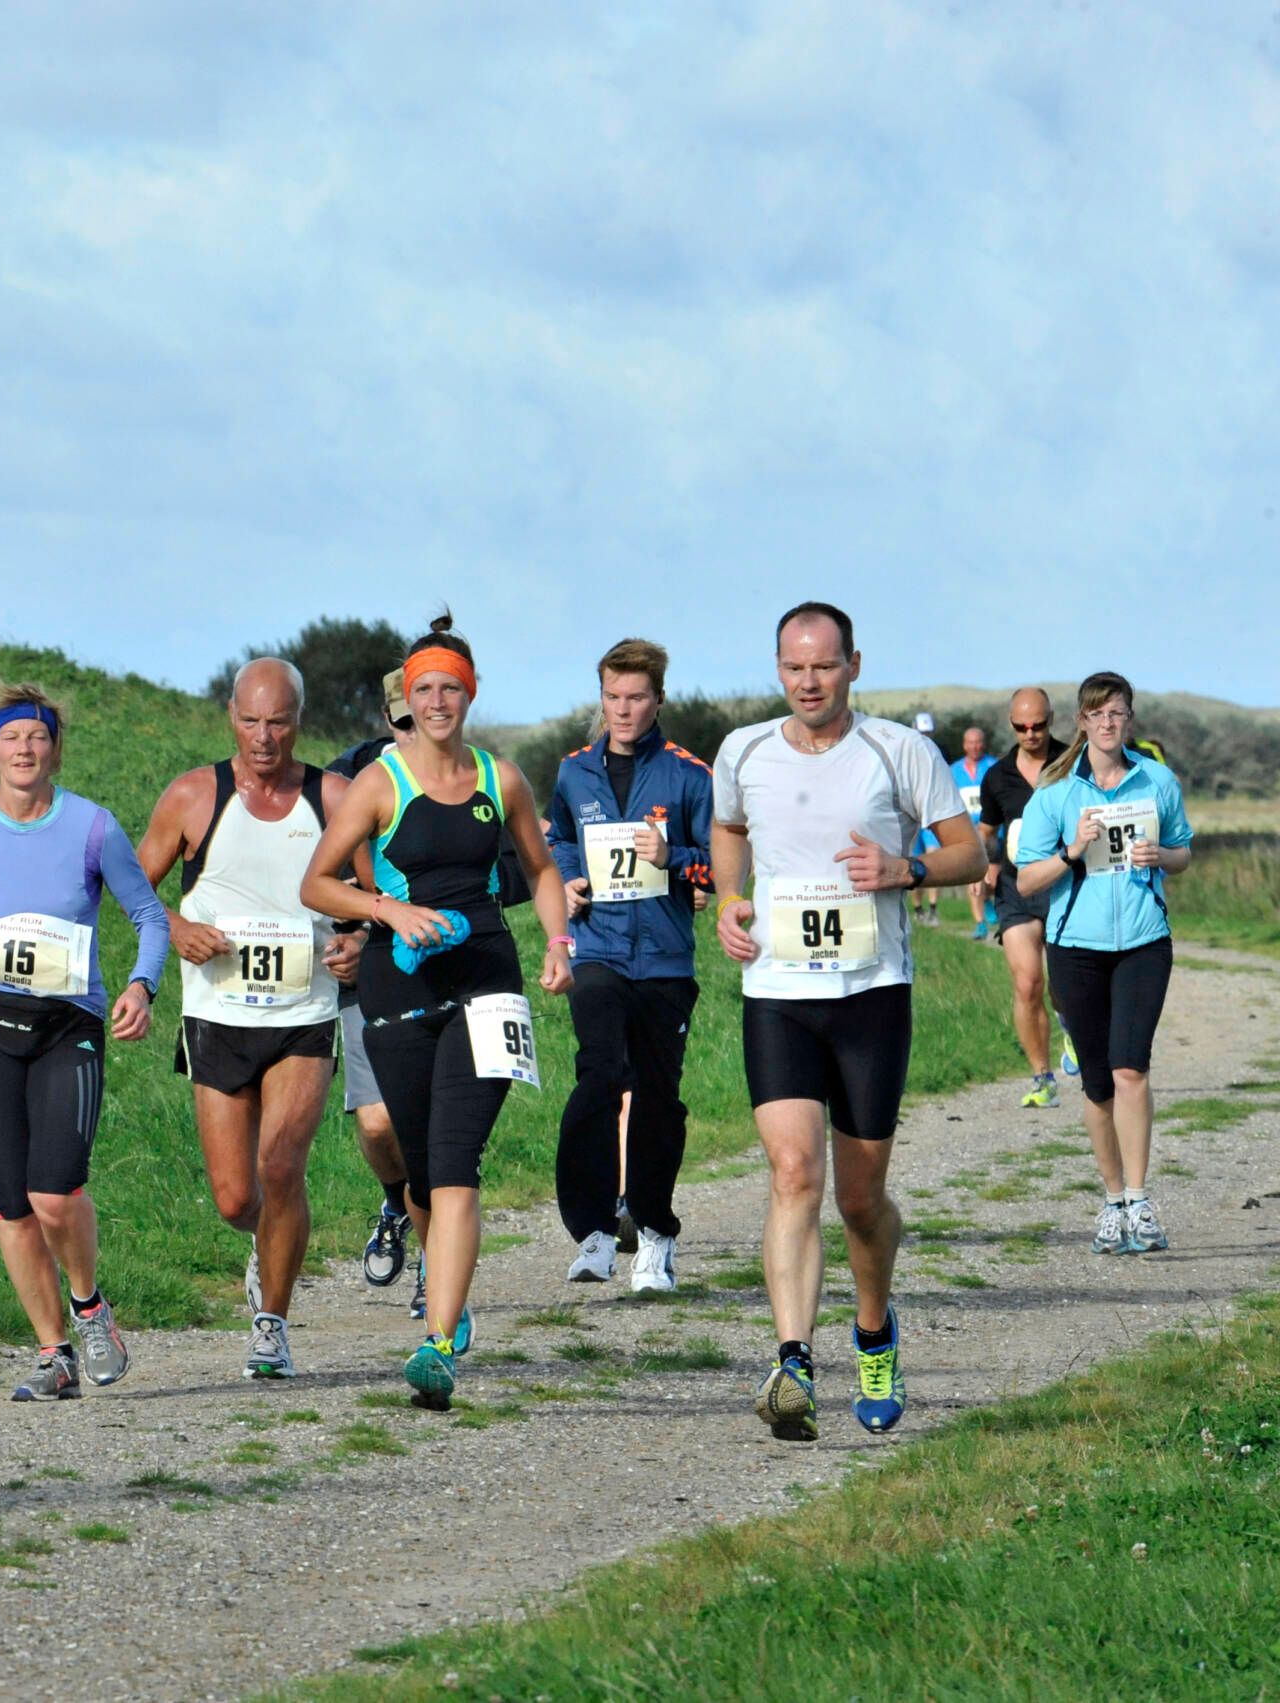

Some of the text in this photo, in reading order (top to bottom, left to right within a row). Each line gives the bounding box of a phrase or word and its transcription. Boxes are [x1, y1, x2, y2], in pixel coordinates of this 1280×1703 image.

[610, 847, 638, 879] 27
[815, 884, 838, 892] RUN
[796, 891, 872, 902] Rantumbecken
[258, 921, 279, 929] RUN
[802, 909, 843, 948] 94
[240, 929, 310, 939] Rantumbecken
[3, 939, 37, 976] 15
[810, 949, 839, 960] Jochen
[238, 945, 284, 982] 131
[4, 974, 32, 985] Claudia
[246, 983, 276, 993] Wilhelm
[503, 1020, 534, 1061] 95
